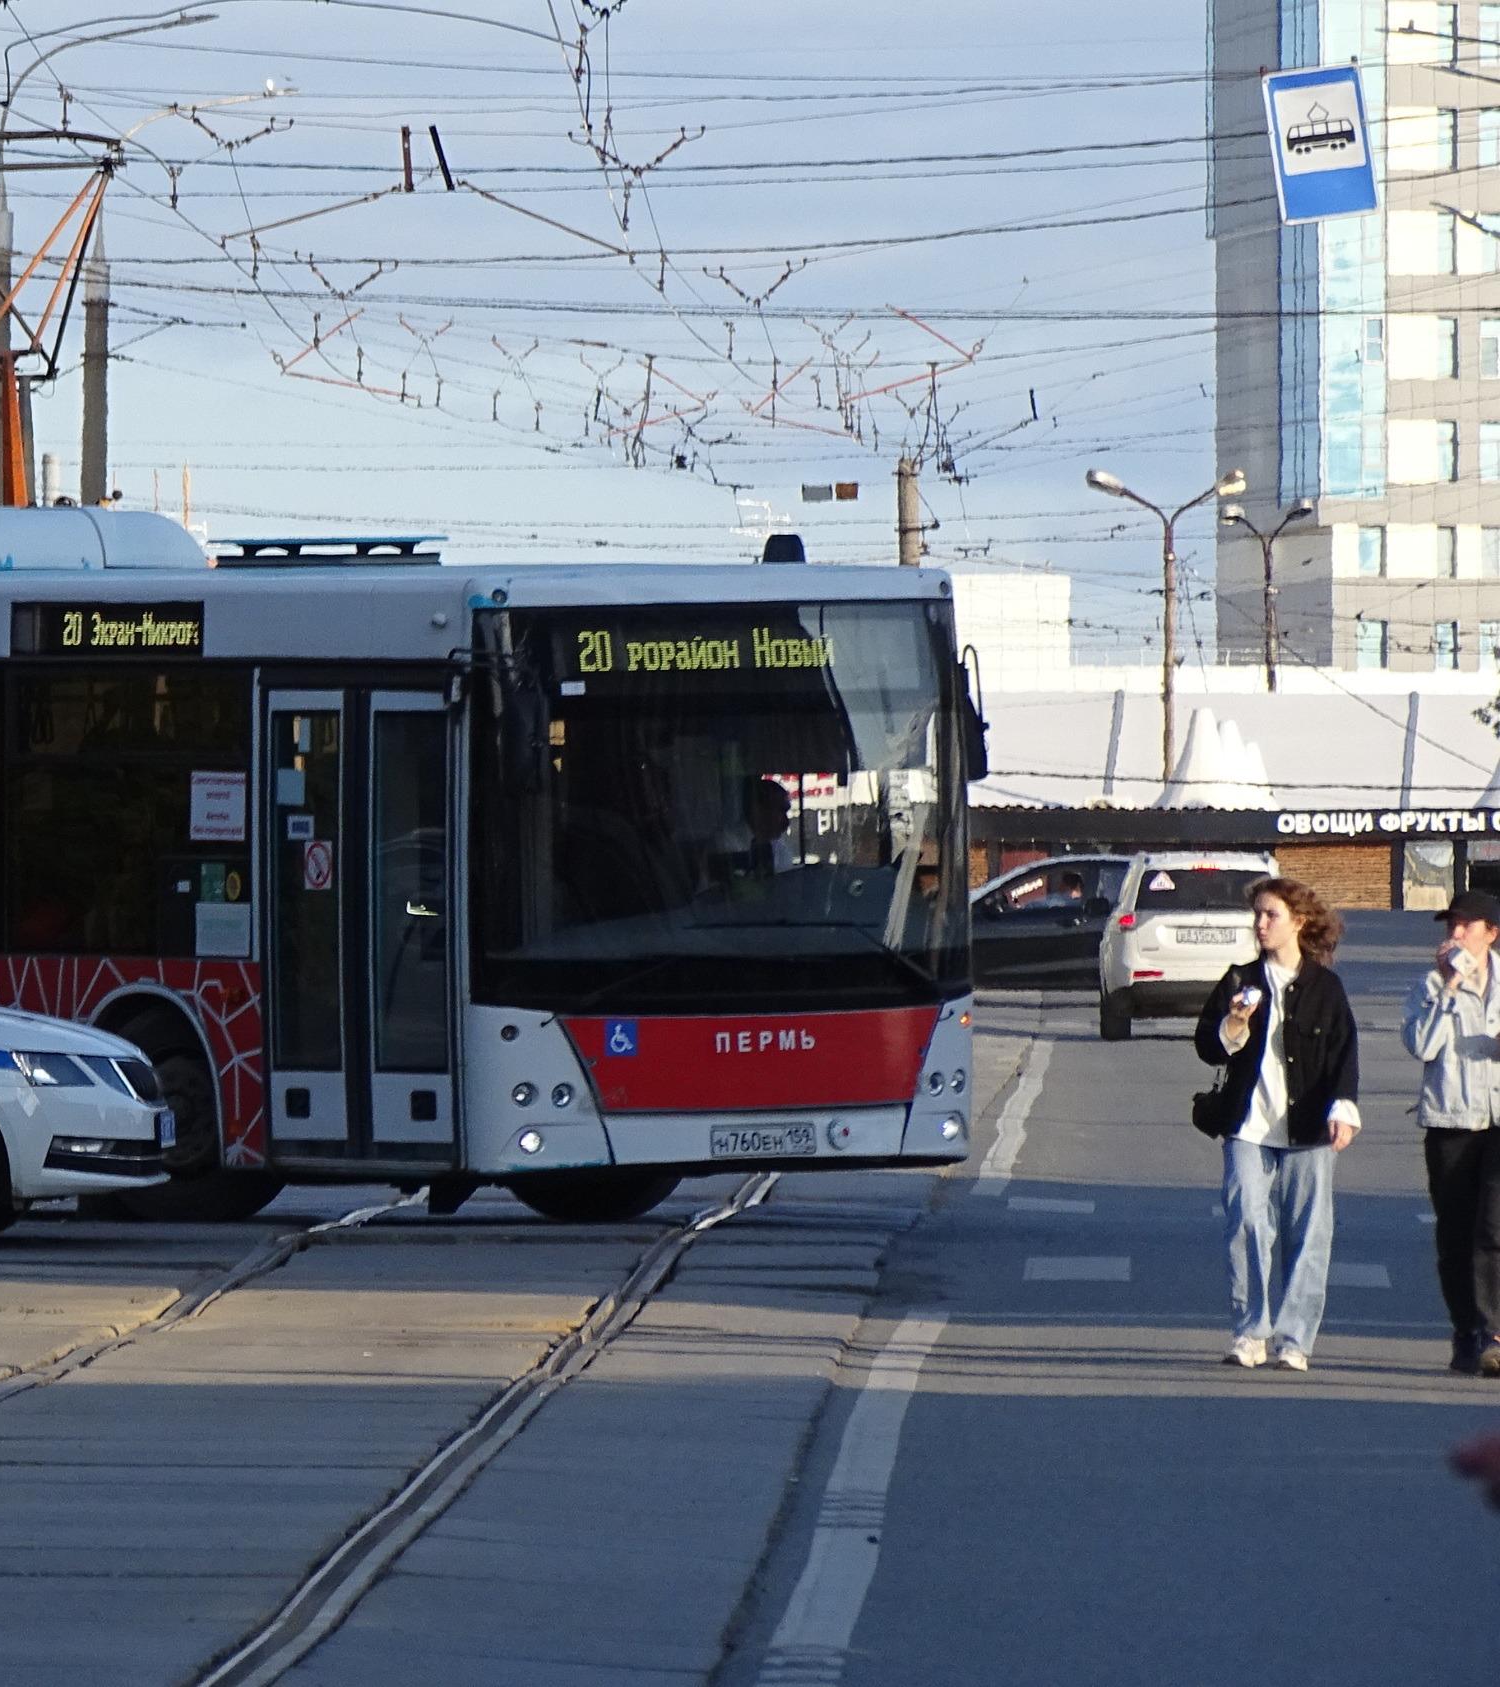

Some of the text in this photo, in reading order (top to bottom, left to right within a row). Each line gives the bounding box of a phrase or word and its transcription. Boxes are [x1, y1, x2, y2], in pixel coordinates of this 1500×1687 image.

[62, 611, 83, 646] 20
[577, 627, 835, 672] 20 рорайон Новый
[1277, 812, 1374, 837] ОВОЩИ
[1379, 811, 1486, 833] ФРУКТЫ
[715, 1028, 816, 1053] ПЕРМЬ
